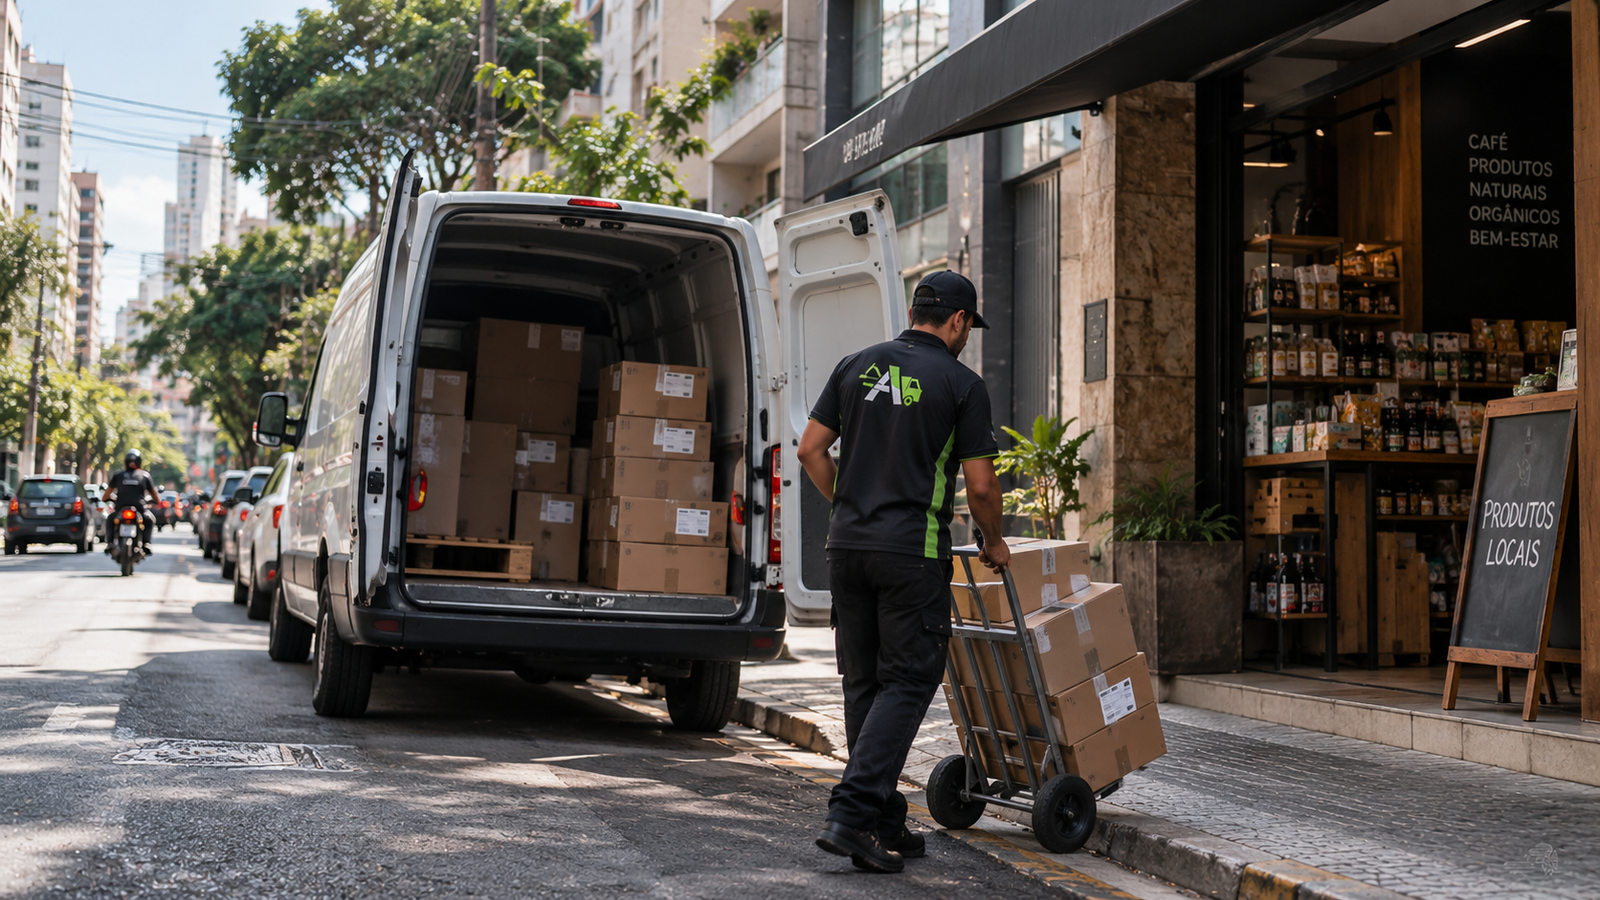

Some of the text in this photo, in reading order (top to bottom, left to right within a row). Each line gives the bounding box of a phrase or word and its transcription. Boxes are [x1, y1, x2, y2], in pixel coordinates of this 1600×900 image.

[1469, 132, 1508, 151] CAFÉ
[1469, 158, 1553, 178] PRODUTOS
[1470, 182, 1547, 201] NATURAIS
[1469, 204, 1560, 225] ORGÂNICOS
[1470, 230, 1559, 249] BEM-ESTAR
[1482, 499, 1555, 530] PRODUTOS
[1485, 538, 1541, 568] LOCAIS
